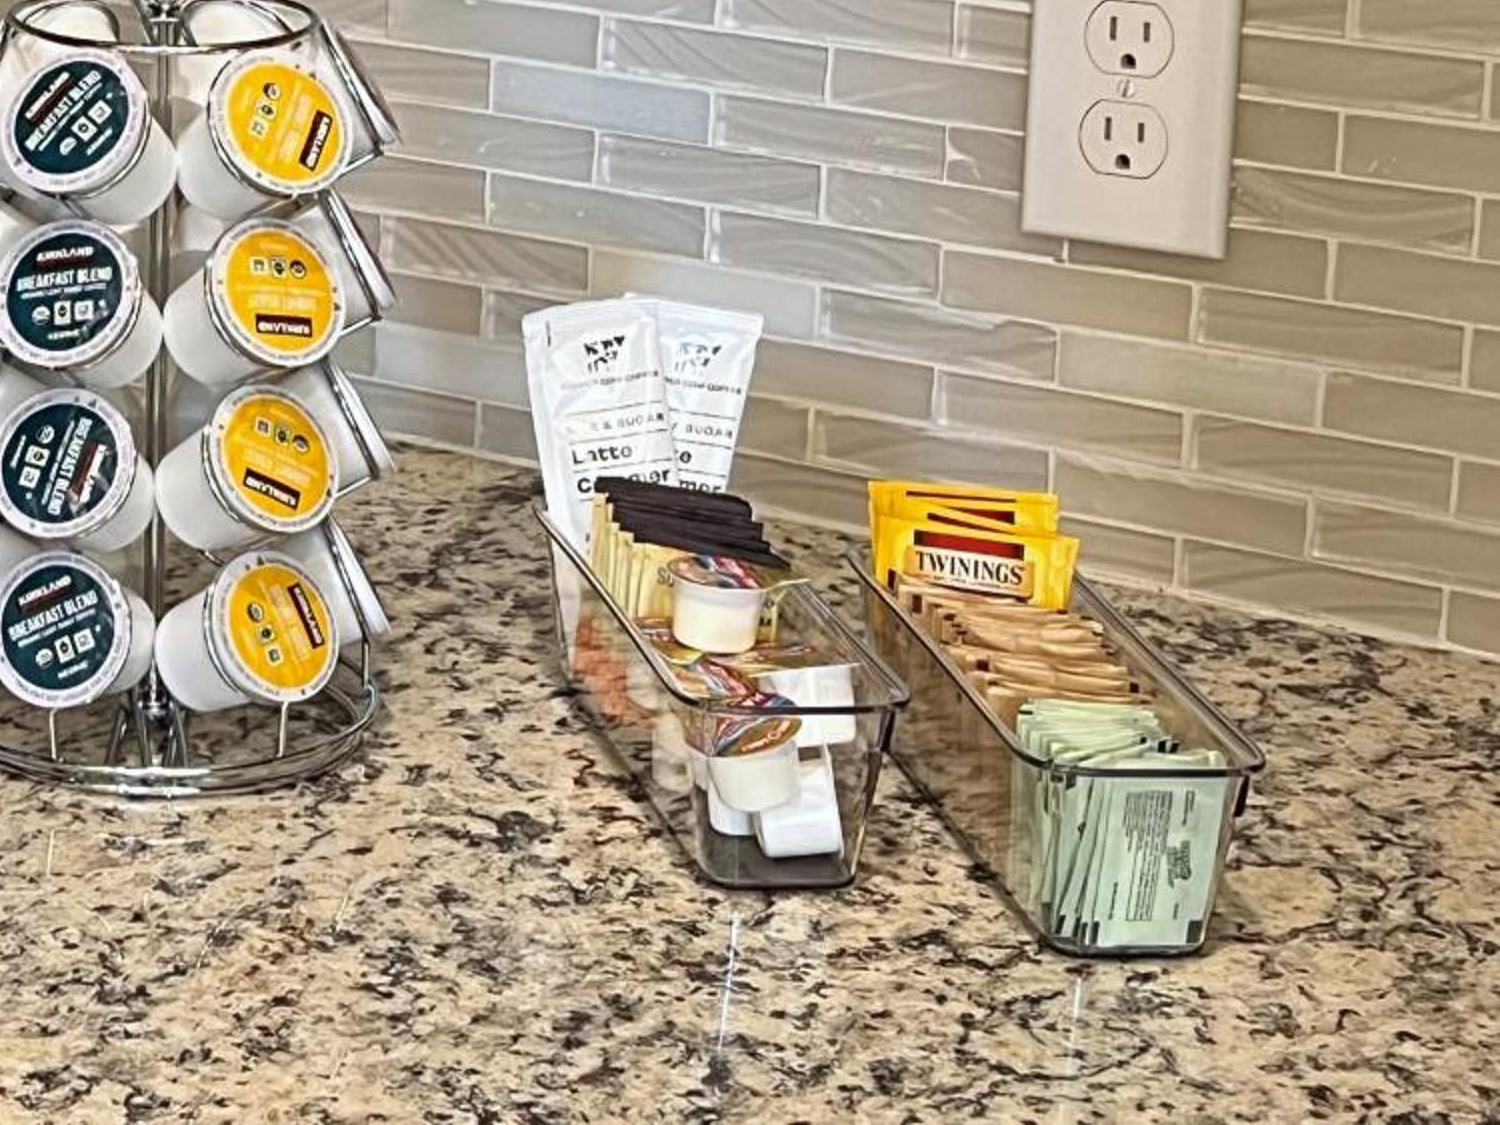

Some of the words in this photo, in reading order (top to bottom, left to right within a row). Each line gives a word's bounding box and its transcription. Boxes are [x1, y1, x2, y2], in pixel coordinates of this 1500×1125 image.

[24, 95, 73, 151] BREAKFAST
[68, 70, 102, 102] BLEND
[36, 246, 94, 262] KIRKLAND
[17, 269, 74, 291] BREAKFAST
[77, 266, 112, 284] BLEND
[59, 417, 93, 479] BREAKFAST
[916, 550, 1026, 586] TWININGS
[8, 604, 64, 642] BREAKFAST
[64, 589, 99, 616] BLEND
